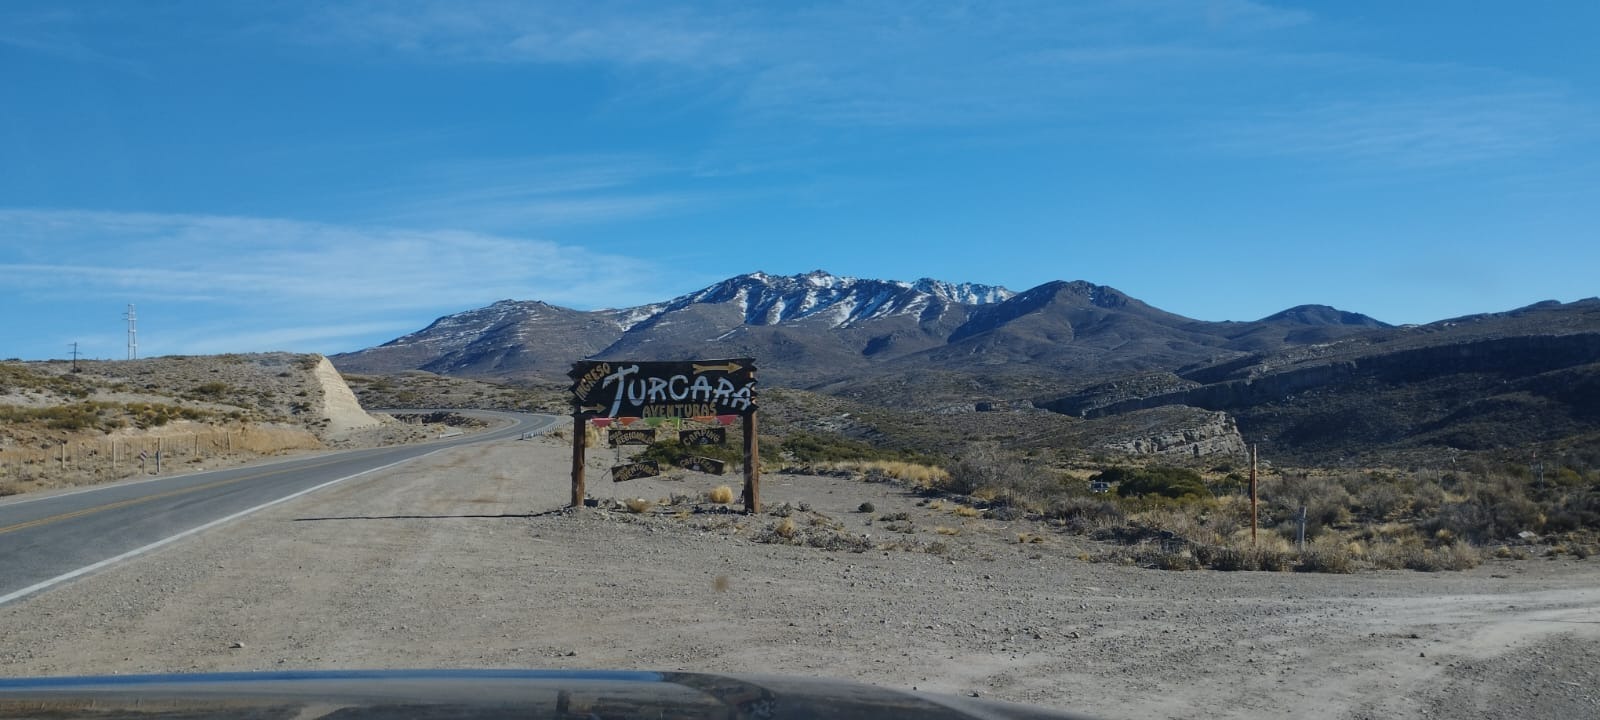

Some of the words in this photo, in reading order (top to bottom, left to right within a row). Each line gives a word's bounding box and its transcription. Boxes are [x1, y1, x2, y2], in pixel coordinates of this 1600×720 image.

[575, 362, 611, 401] INGRESO
[642, 403, 717, 419] AVENTURAS
[683, 430, 721, 446] CAMPING
